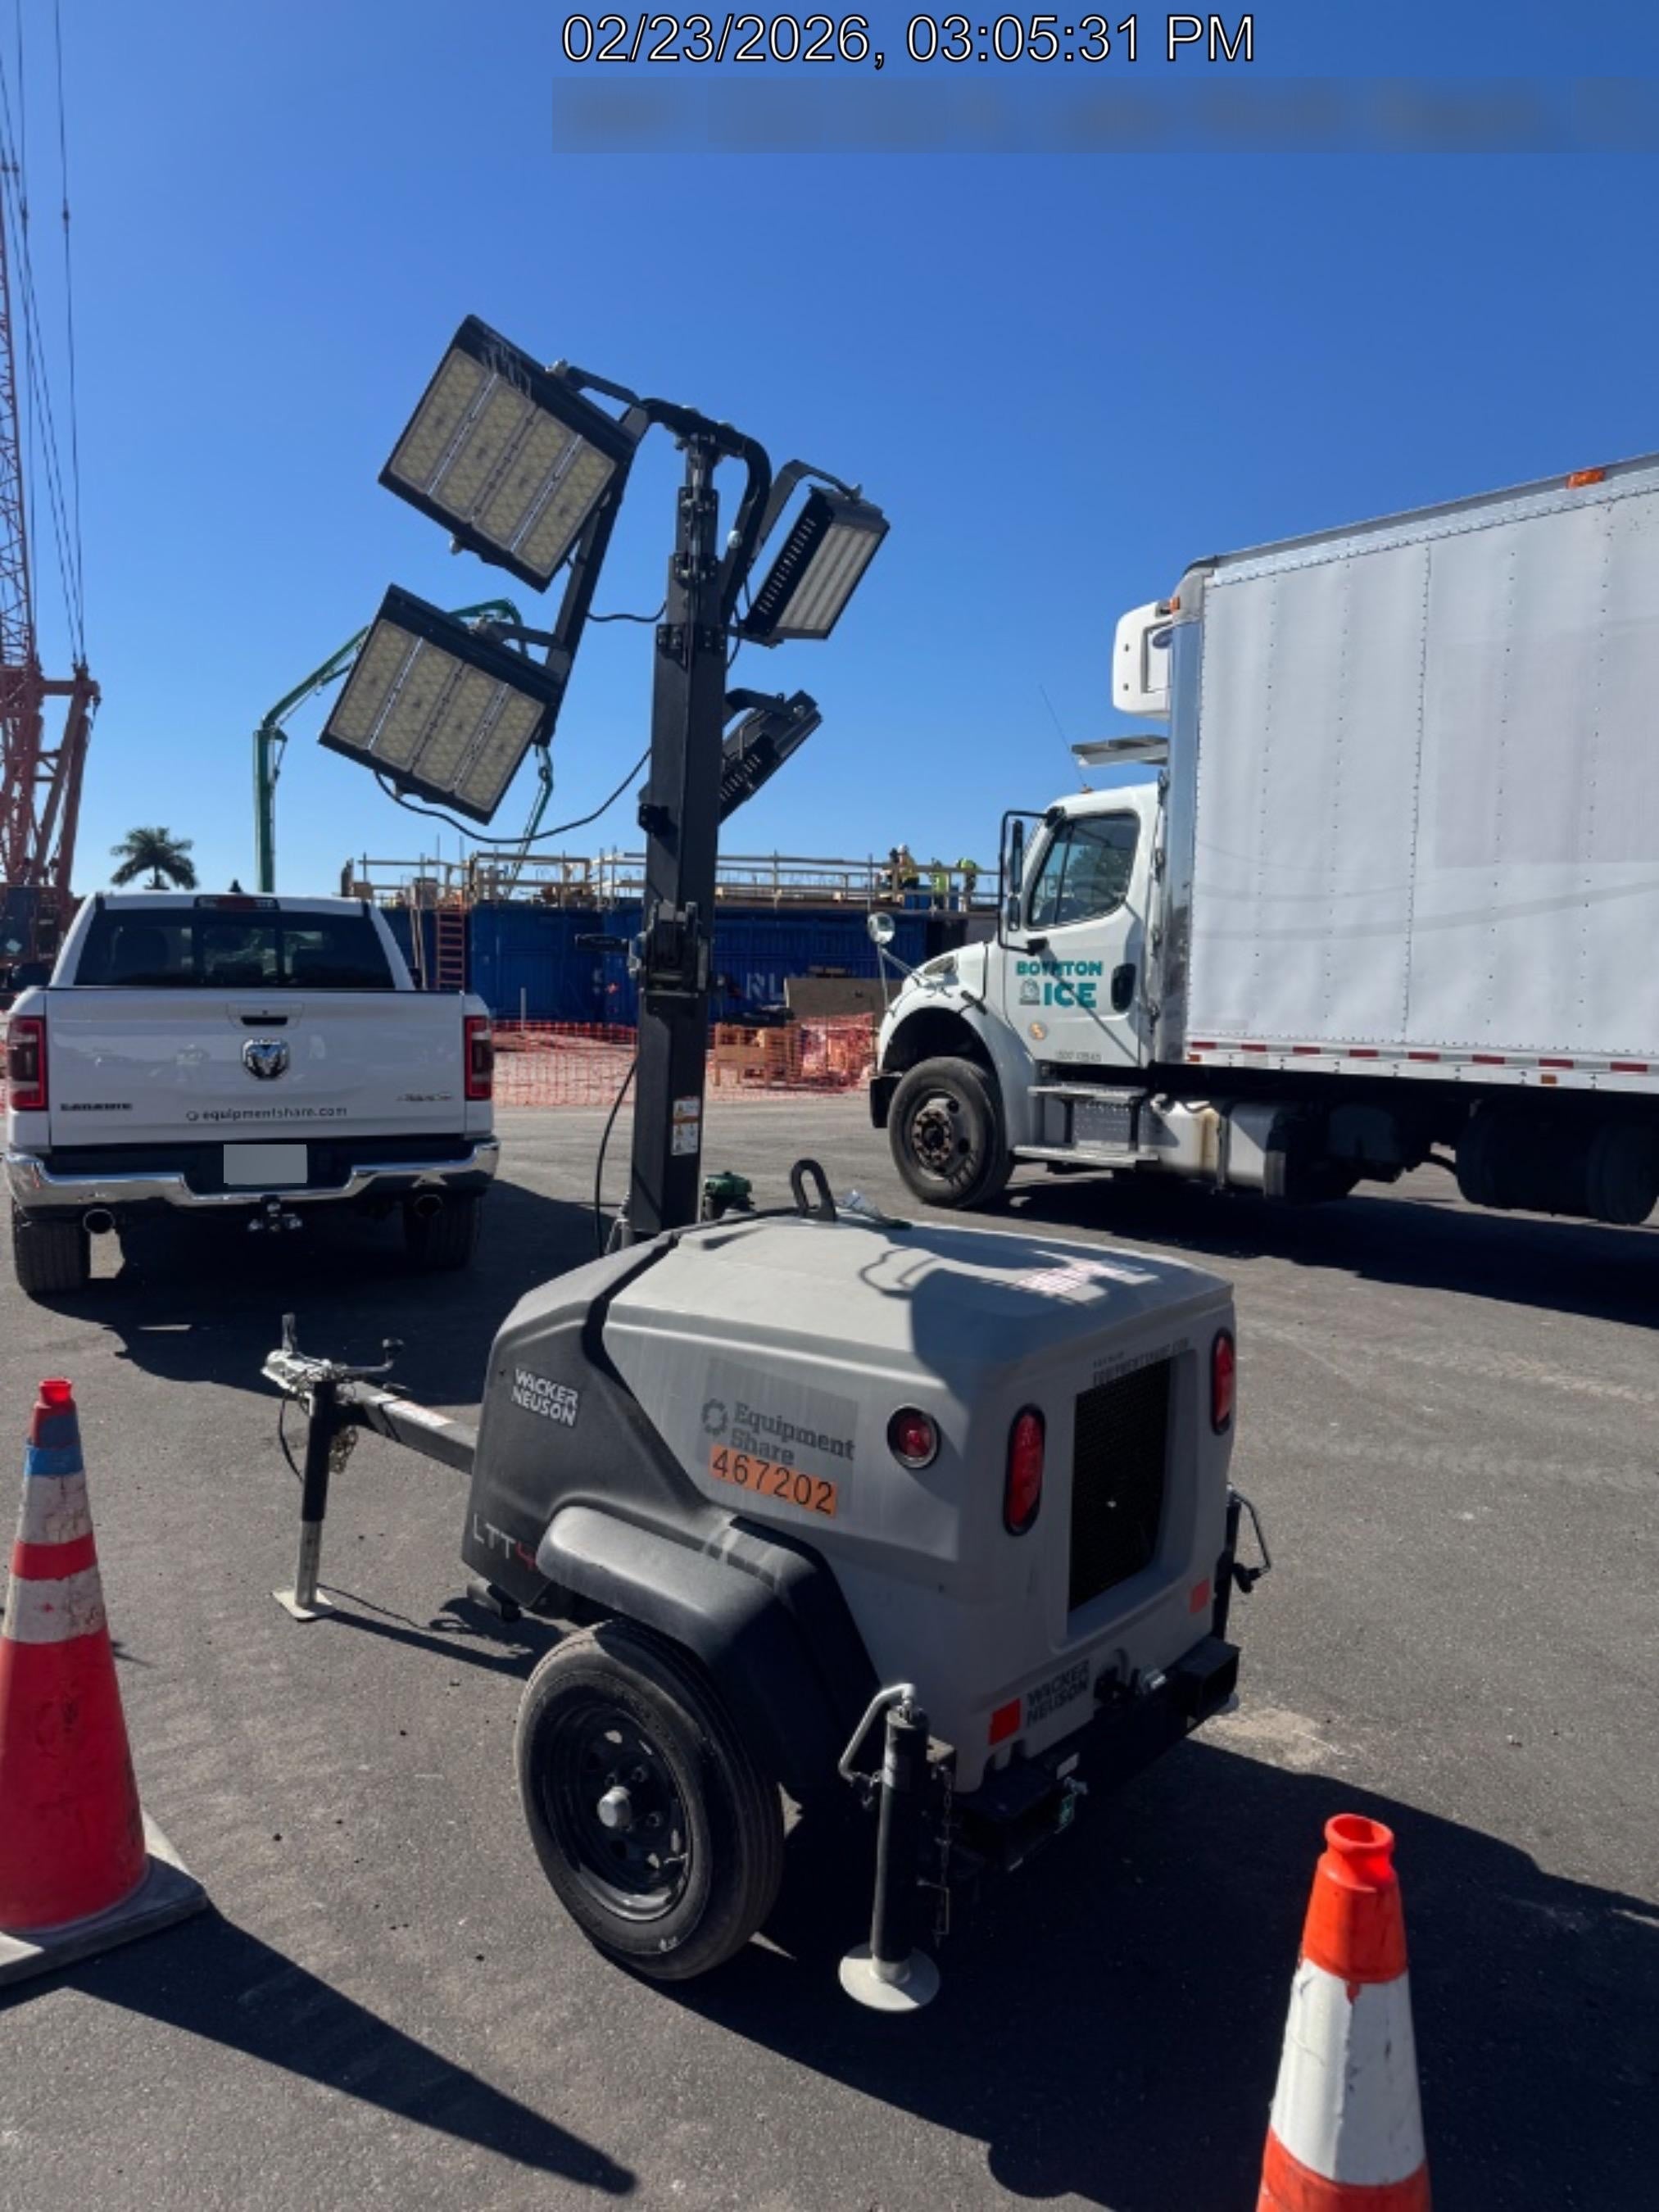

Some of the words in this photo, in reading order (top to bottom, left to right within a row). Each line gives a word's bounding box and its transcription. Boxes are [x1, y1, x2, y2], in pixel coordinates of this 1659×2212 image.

[1016, 961, 1103, 976] BOYNTON
[1044, 982, 1097, 1008] ICE
[510, 1385, 576, 1426] NEUSON
[514, 1367, 578, 1408] WACKER
[730, 1427, 795, 1466] Share
[734, 1402, 856, 1462] Equipment
[712, 1448, 834, 1516] 467202
